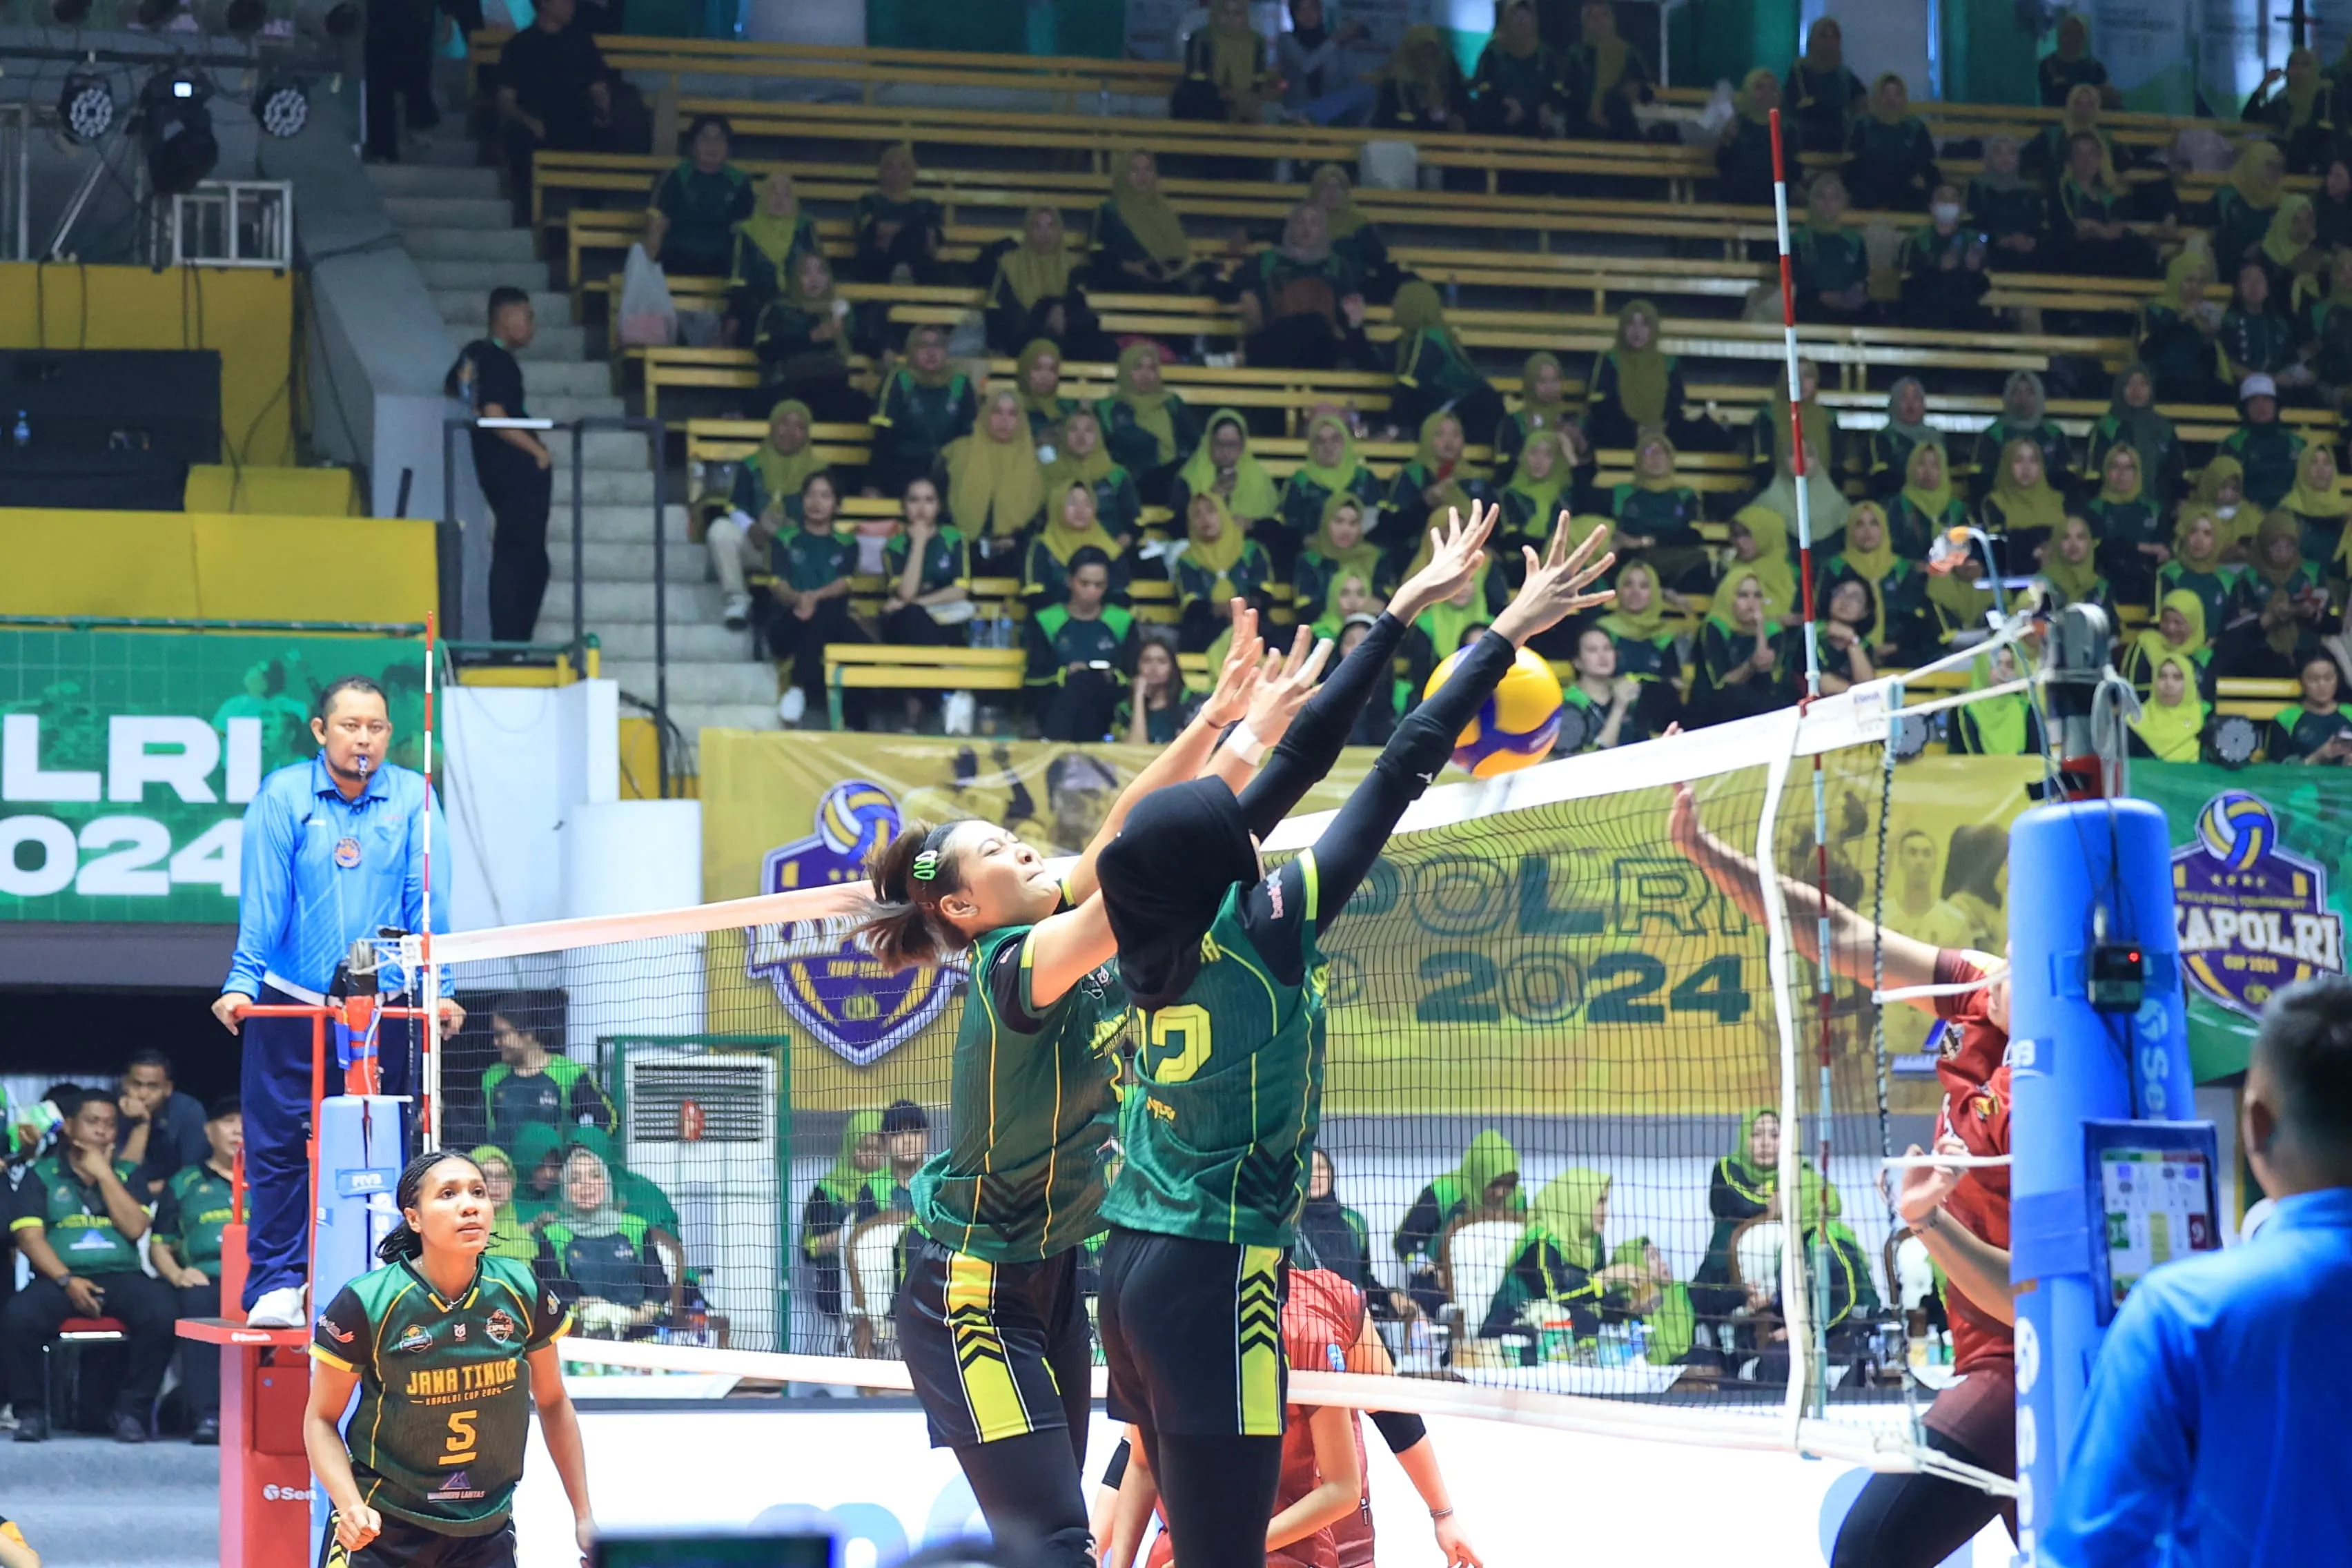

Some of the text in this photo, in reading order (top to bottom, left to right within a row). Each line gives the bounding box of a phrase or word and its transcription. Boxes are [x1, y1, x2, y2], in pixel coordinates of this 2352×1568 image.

[3, 714, 262, 804] LRI
[1417, 950, 1750, 1025] 2024
[405, 1357, 518, 1396] JAWA TIMUR
[464, 1390, 480, 1402] CUP
[481, 1387, 502, 1398] 2024
[445, 1409, 478, 1452] 5
